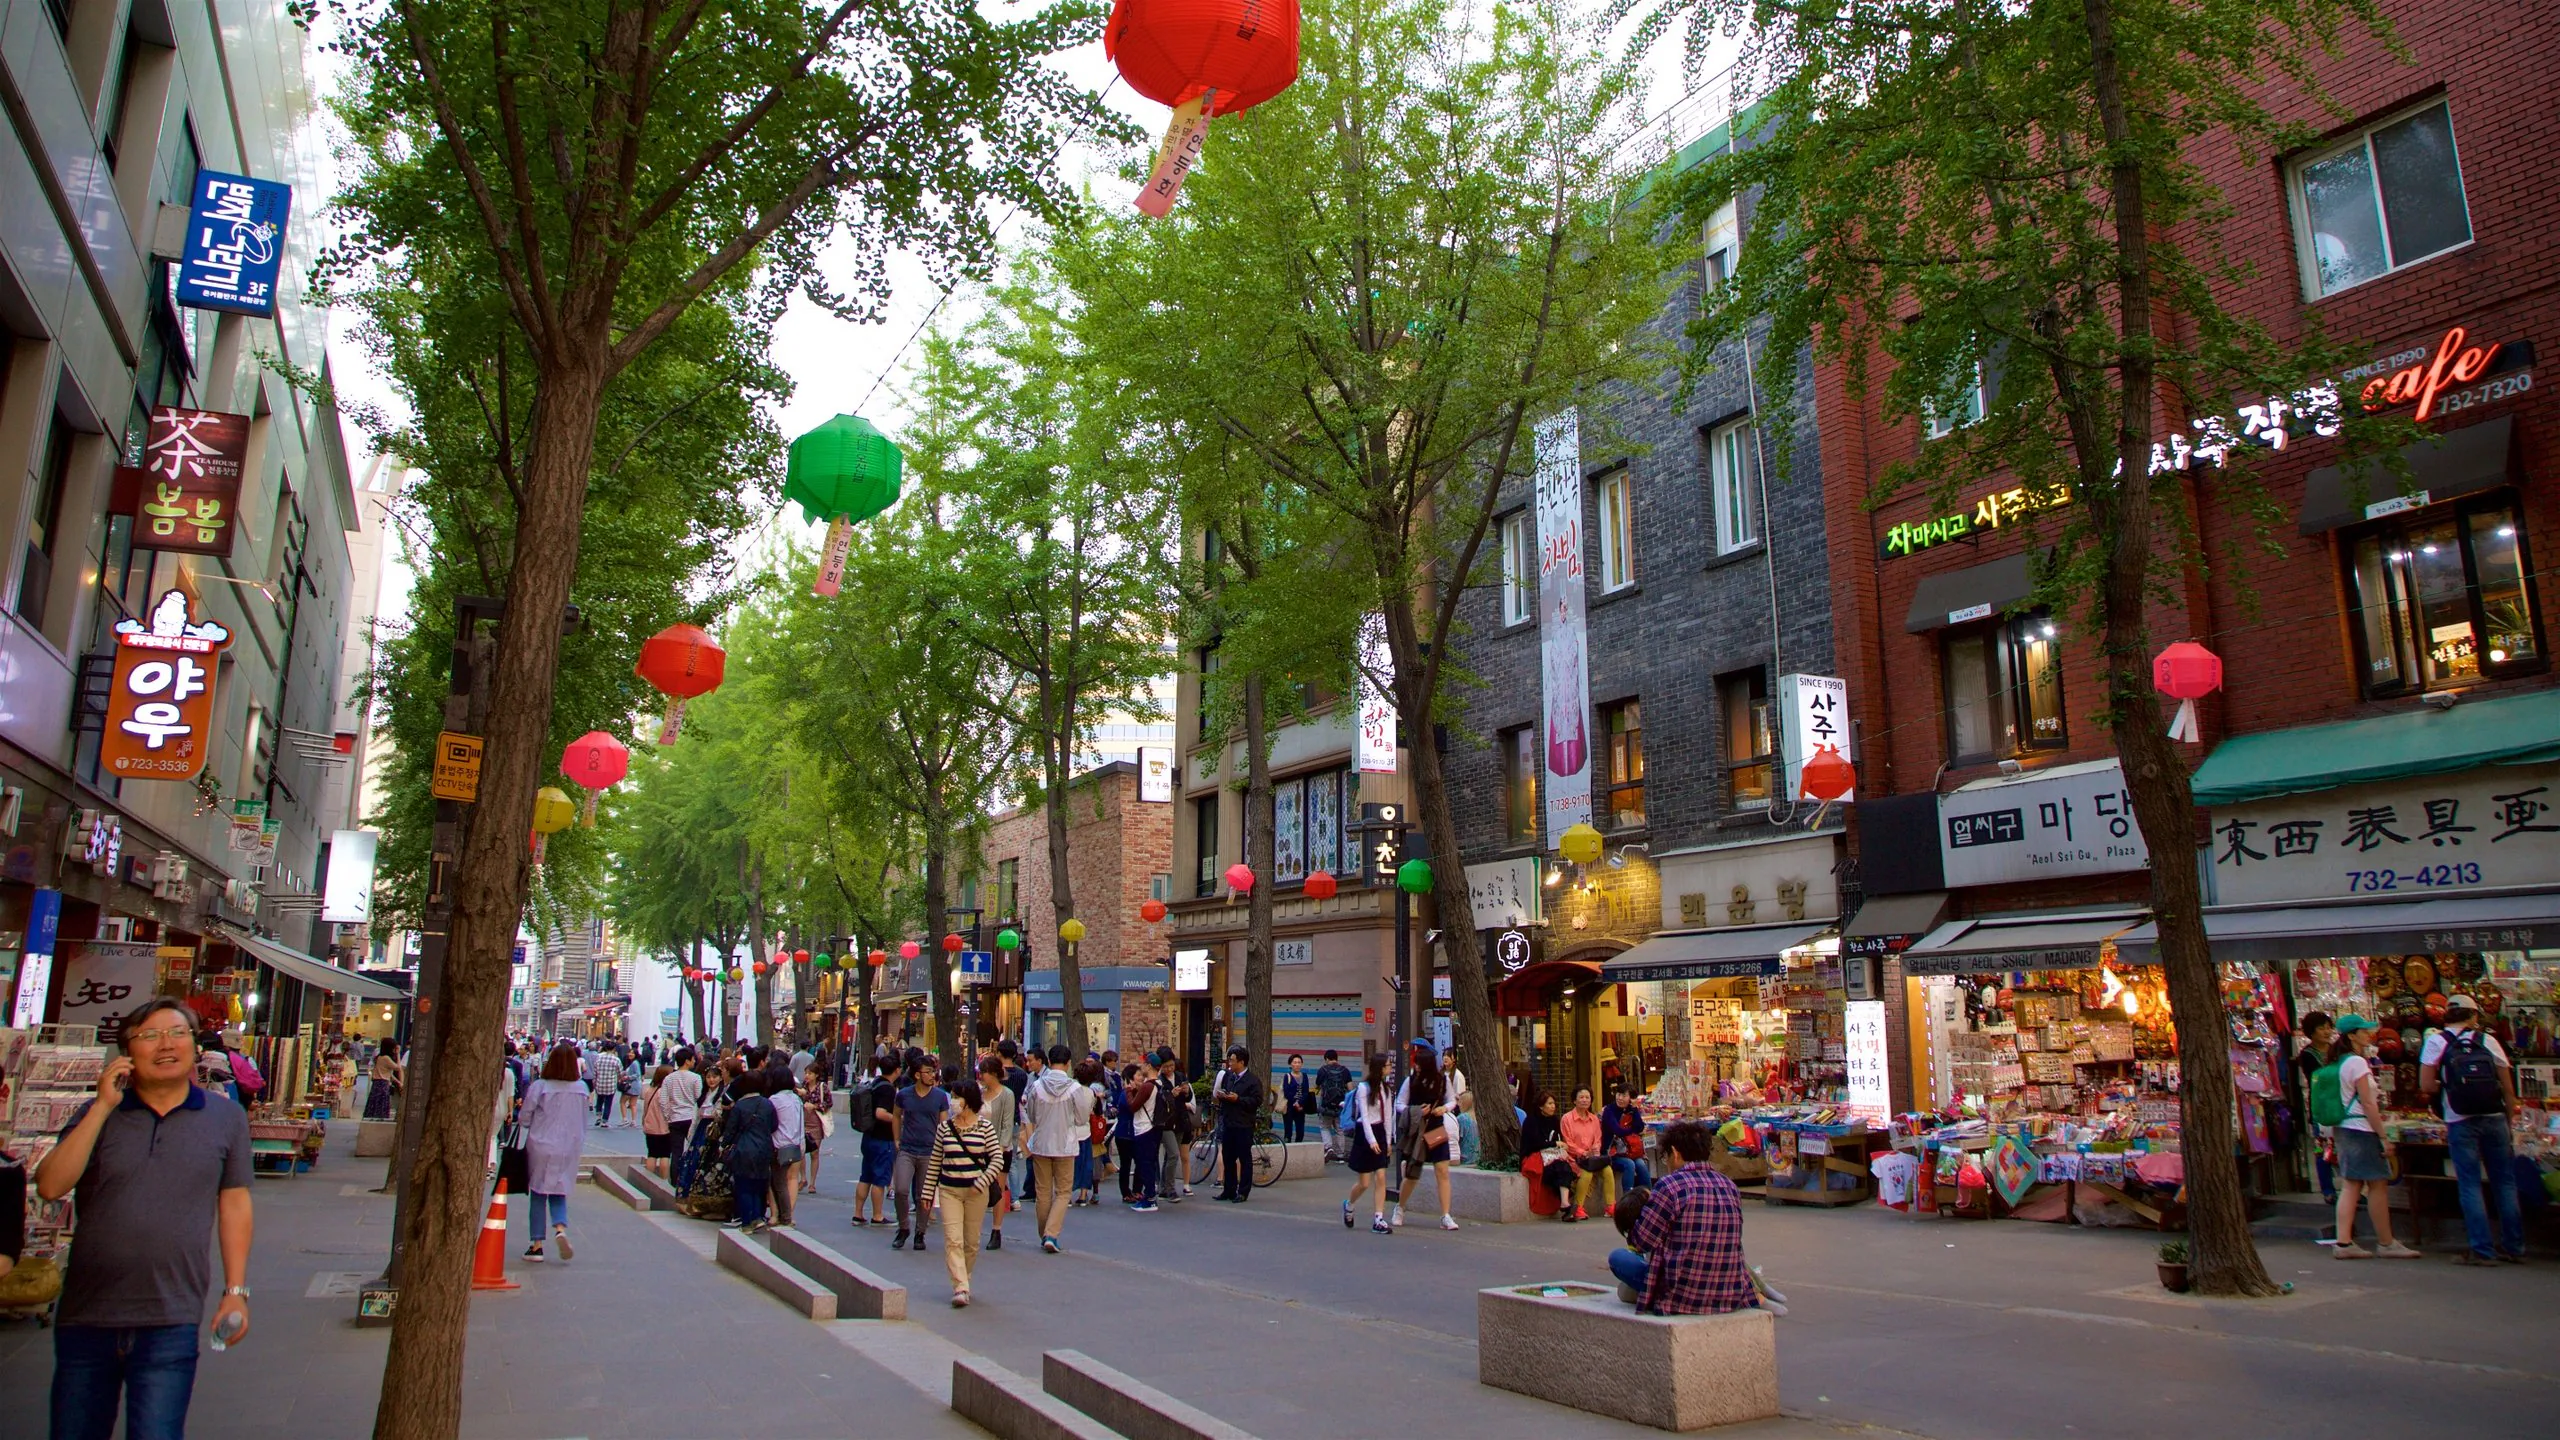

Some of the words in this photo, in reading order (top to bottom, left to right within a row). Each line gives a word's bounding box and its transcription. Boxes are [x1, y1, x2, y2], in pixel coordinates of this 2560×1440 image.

[1155, 133, 1204, 198] 연등회
[248, 281, 269, 296] 3F
[2342, 359, 2387, 382] SINCE
[2389, 347, 2426, 369] 1990
[2360, 326, 2500, 423] cafe
[2438, 373, 2533, 415] 732-7320
[147, 407, 224, 480] 茶
[196, 457, 211, 465] TEA
[212, 458, 239, 467] HOUSE
[144, 482, 226, 543] 봄봄
[1887, 514, 1968, 555] 차마시고
[1542, 519, 1578, 579] 차빔
[825, 540, 848, 584] 연등회
[2432, 643, 2473, 663] 전통차
[2372, 656, 2393, 672] 타로
[1799, 677, 1822, 688] SINCE
[1824, 680, 1843, 690] 1990
[122, 657, 205, 748] 야우
[2035, 716, 2057, 730] 상담
[131, 758, 190, 772] 723-3536
[1387, 757, 1395, 766] 3F
[1953, 813, 2018, 846] 얼씨구
[2038, 789, 2134, 842] 마당
[2057, 850, 2073, 862] Ssi
[2106, 845, 2136, 857] Plaza
[2345, 862, 2483, 892] 732-4213
[1679, 881, 1808, 928] 백운당
[1866, 938, 1887, 953] 사주
[2423, 932, 2455, 950] 동서
[2460, 930, 2494, 948] 표구
[2499, 928, 2536, 946] 화랑
[100, 946, 124, 957] Live
[130, 946, 156, 957] Cafe
[2044, 950, 2092, 966] MADANG
[1616, 969, 1644, 980] 표구전문
[1651, 968, 1673, 978] 고서화
[1719, 962, 1763, 974] 735-2266
[1849, 1021, 1878, 1036] 사주
[1850, 1039, 1880, 1054] 작명
[1851, 1057, 1881, 1071] 타로
[1852, 1075, 1882, 1091] 택일
